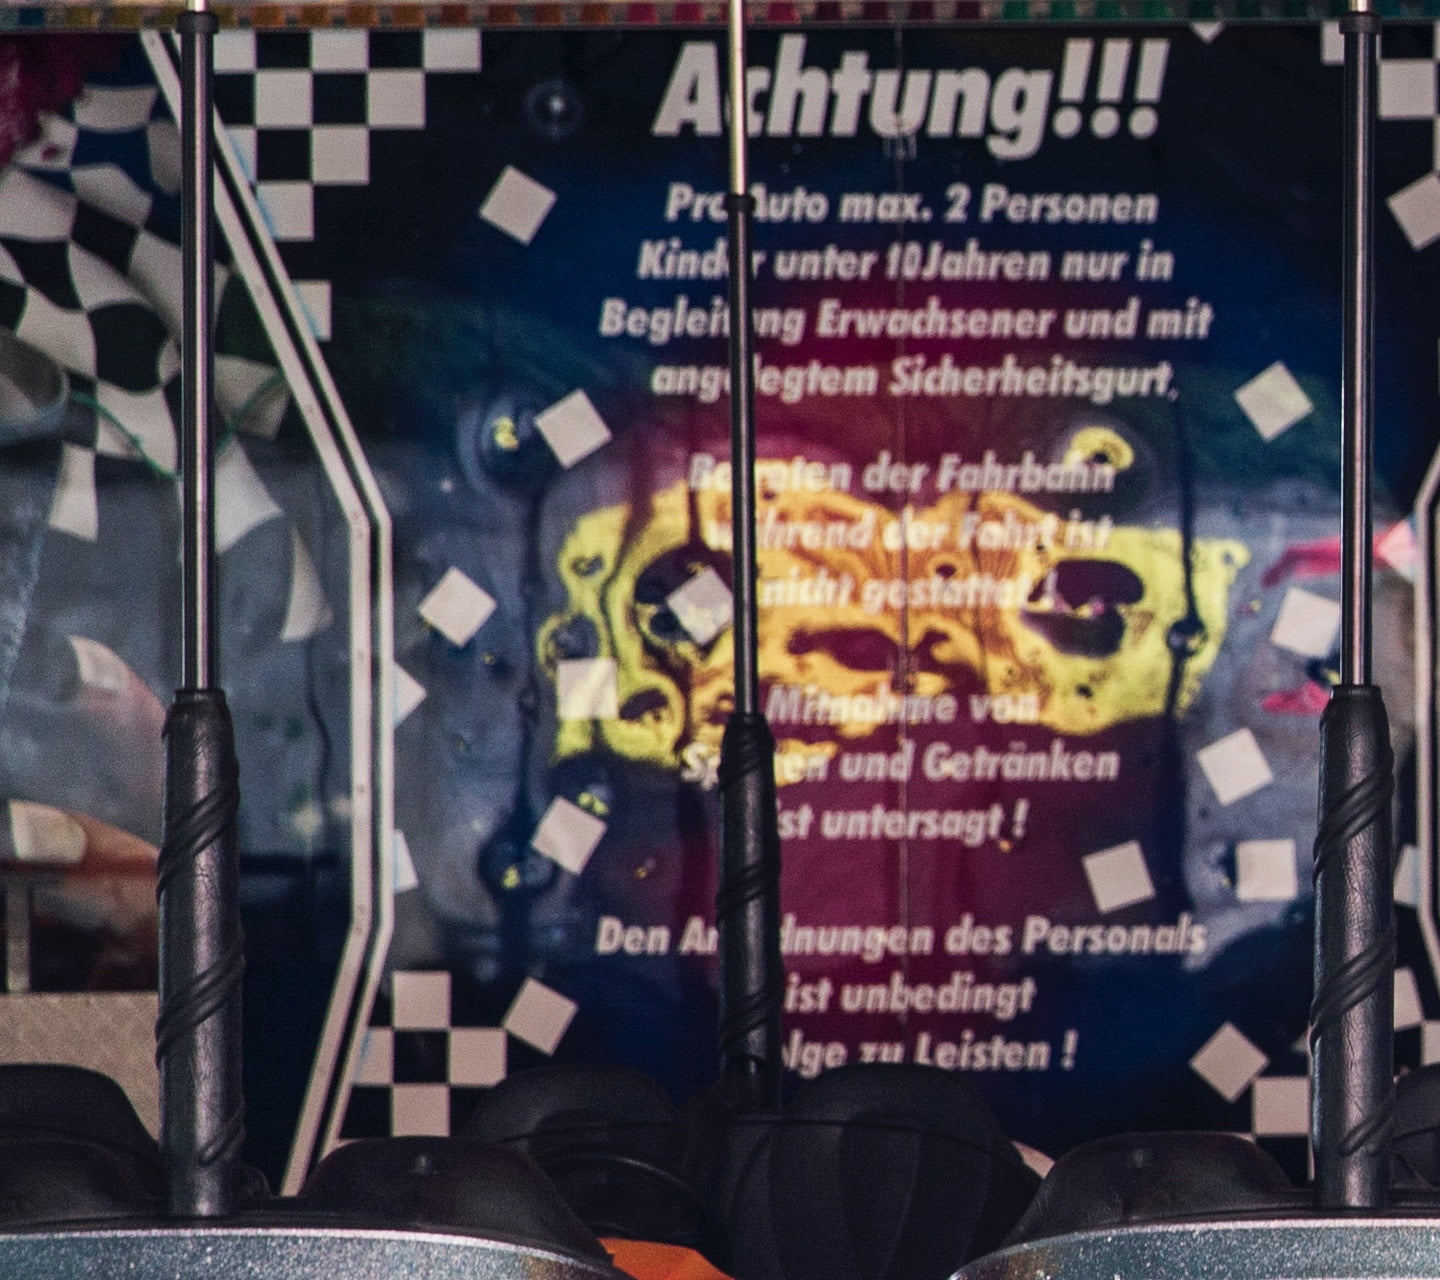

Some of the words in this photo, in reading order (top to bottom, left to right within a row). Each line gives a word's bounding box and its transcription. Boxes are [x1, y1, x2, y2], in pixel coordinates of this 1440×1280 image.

[651, 33, 1170, 160] Achtung!!!
[750, 182, 829, 223] Auto
[839, 191, 932, 223] max.
[946, 184, 971, 222] 2
[981, 184, 1158, 223] Personen
[637, 237, 768, 280] Kindr
[774, 244, 878, 280] unter
[1059, 250, 1129, 281] nur
[1135, 238, 1174, 281] in
[817, 295, 1057, 339] Erwachsener
[1064, 295, 1140, 339] und
[1146, 298, 1212, 339] mit
[862, 452, 929, 492] der
[937, 451, 1115, 493] Fahrbahn
[883, 507, 947, 550] der
[960, 508, 1057, 551] Fahrt
[1065, 508, 1113, 551] ist
[762, 565, 855, 607] nicht
[766, 681, 958, 725] Mitnahme
[968, 691, 1040, 724] von
[839, 739, 916, 781] und
[922, 738, 1119, 781] Getränken
[819, 802, 1002, 847] untersagt
[1011, 800, 1029, 839] !
[595, 916, 670, 956] Den
[945, 915, 1012, 956] des
[1021, 914, 1207, 956] Personals
[784, 972, 832, 1013] ist
[839, 973, 1037, 1019] unbedingt
[913, 1029, 1051, 1071] Leisten
[1060, 1028, 1079, 1070] !
